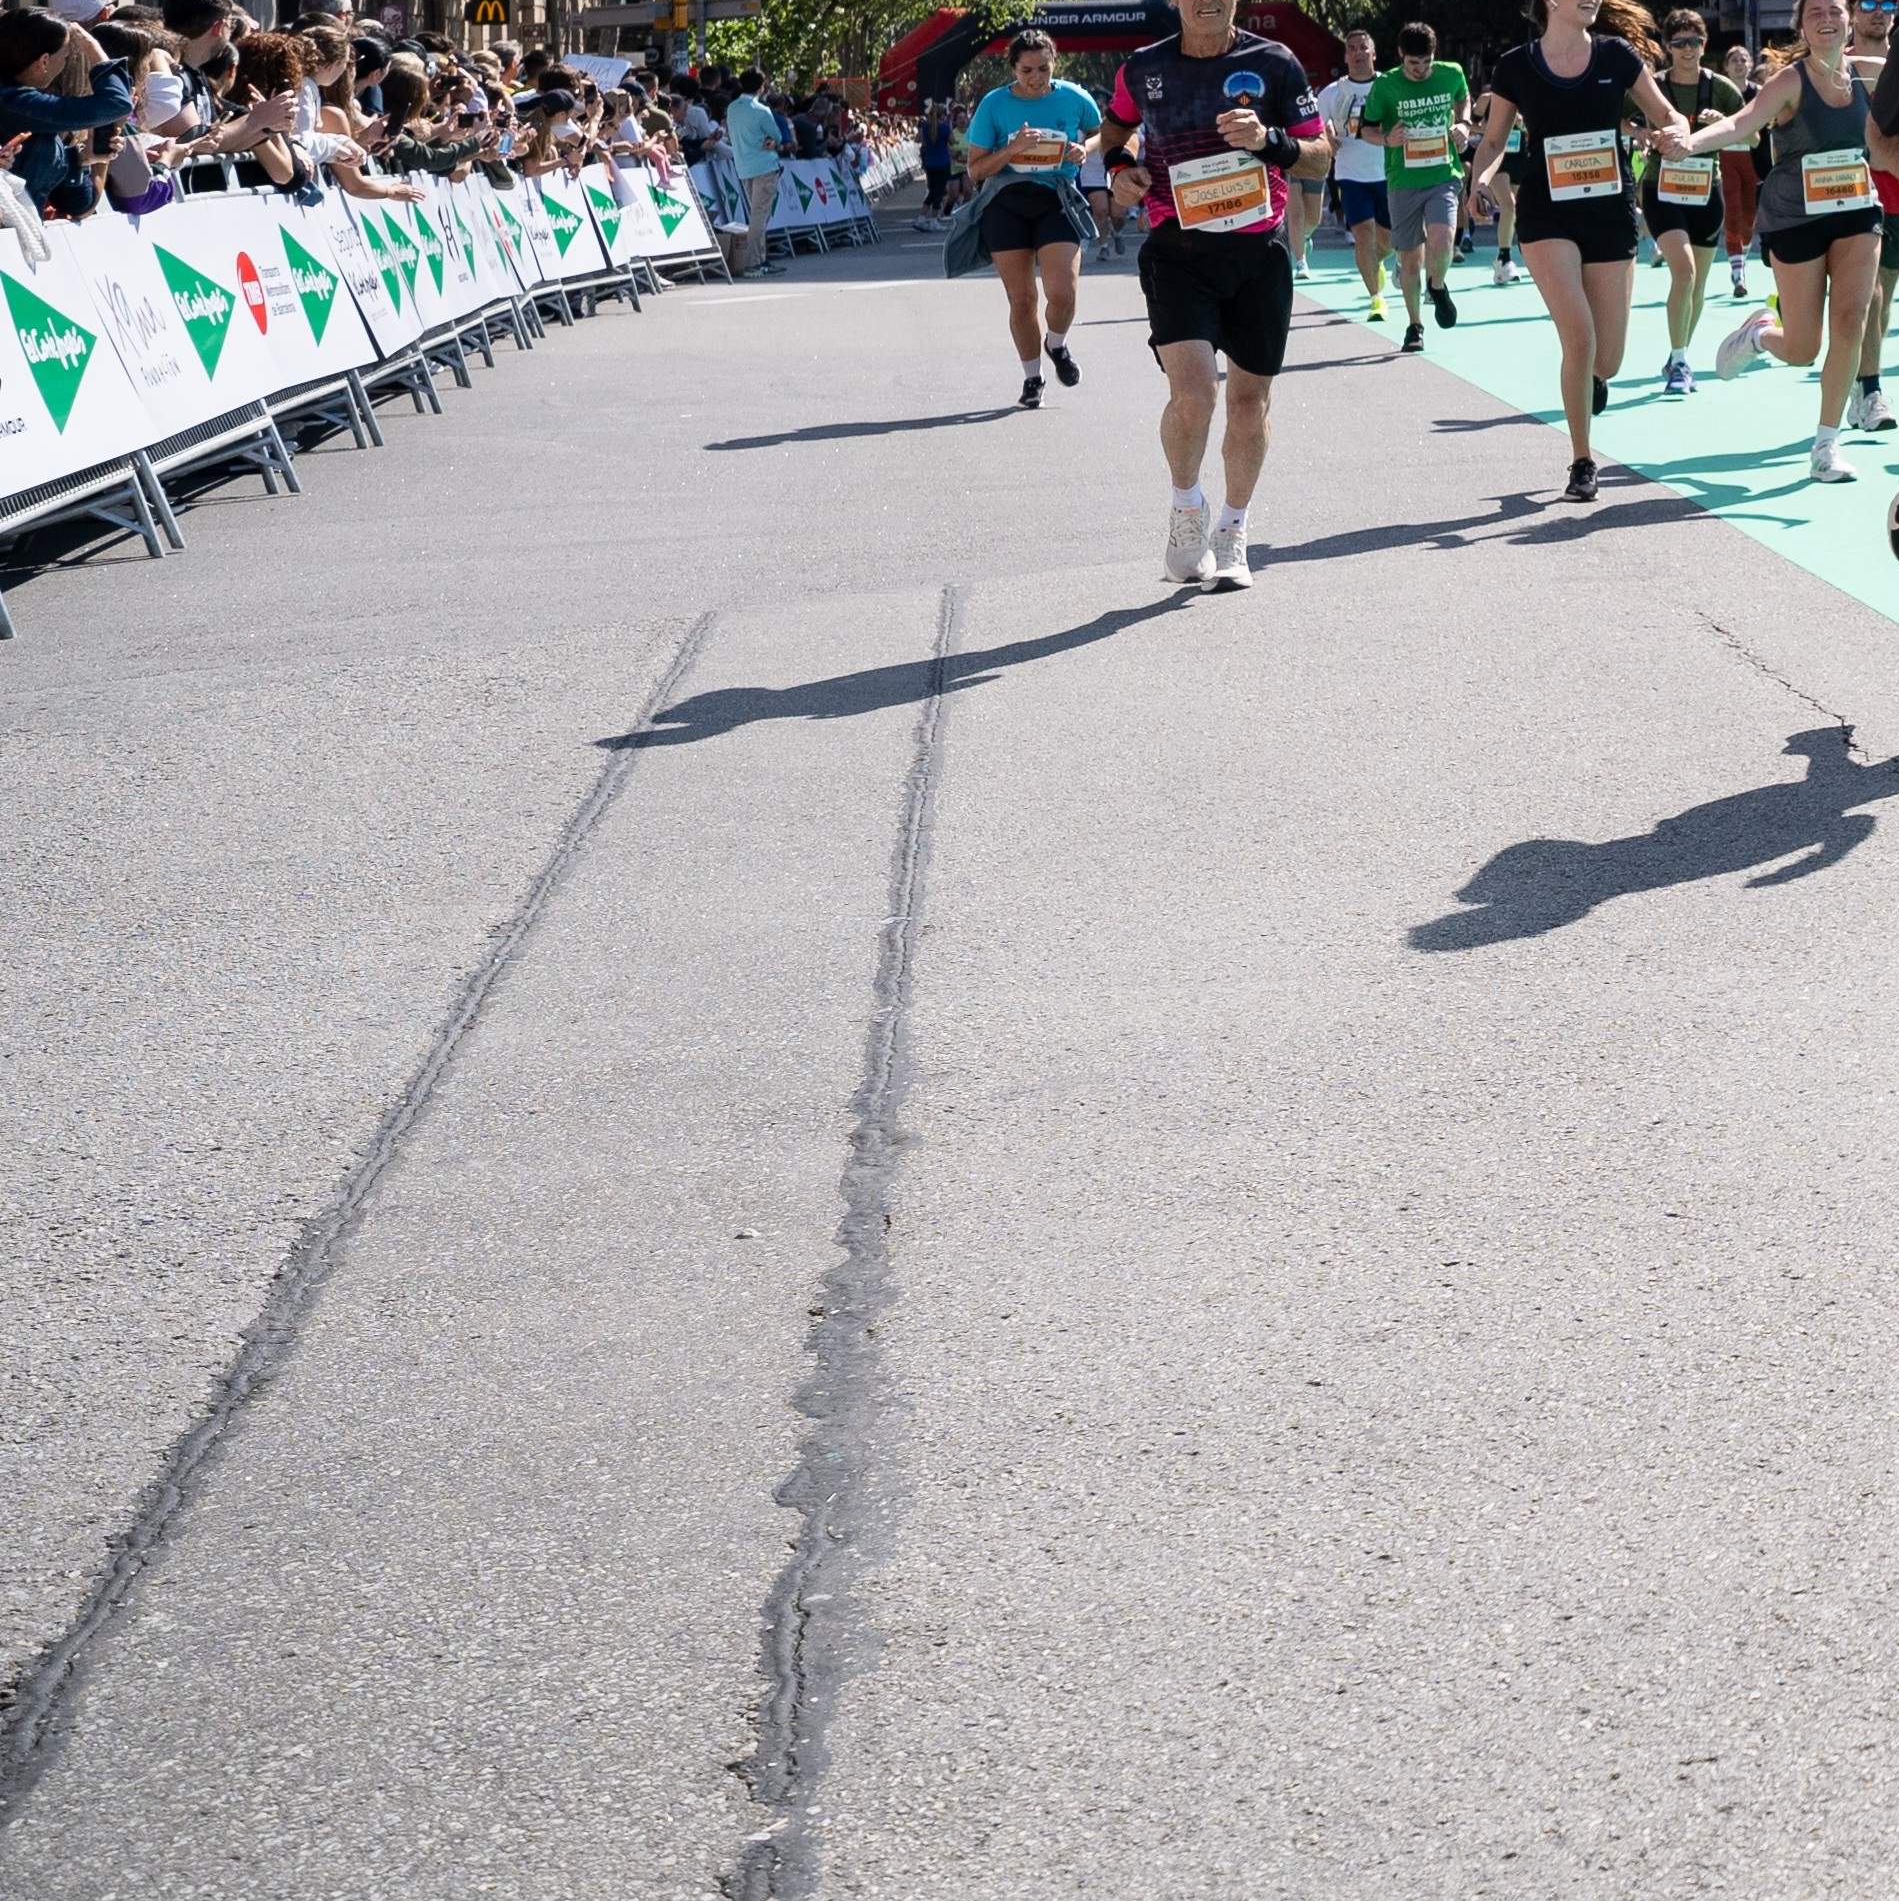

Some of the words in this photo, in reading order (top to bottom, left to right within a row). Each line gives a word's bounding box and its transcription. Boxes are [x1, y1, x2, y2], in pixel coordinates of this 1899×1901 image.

[1027, 14, 1080, 27] UNDER
[1082, 11, 1147, 25] ARMOUR
[1396, 92, 1452, 110] JORNADES
[1397, 103, 1452, 118] Esportives
[1563, 157, 1601, 170] CARLOTA
[1220, 180, 1245, 196] LUIS
[1207, 198, 1243, 215] 17186
